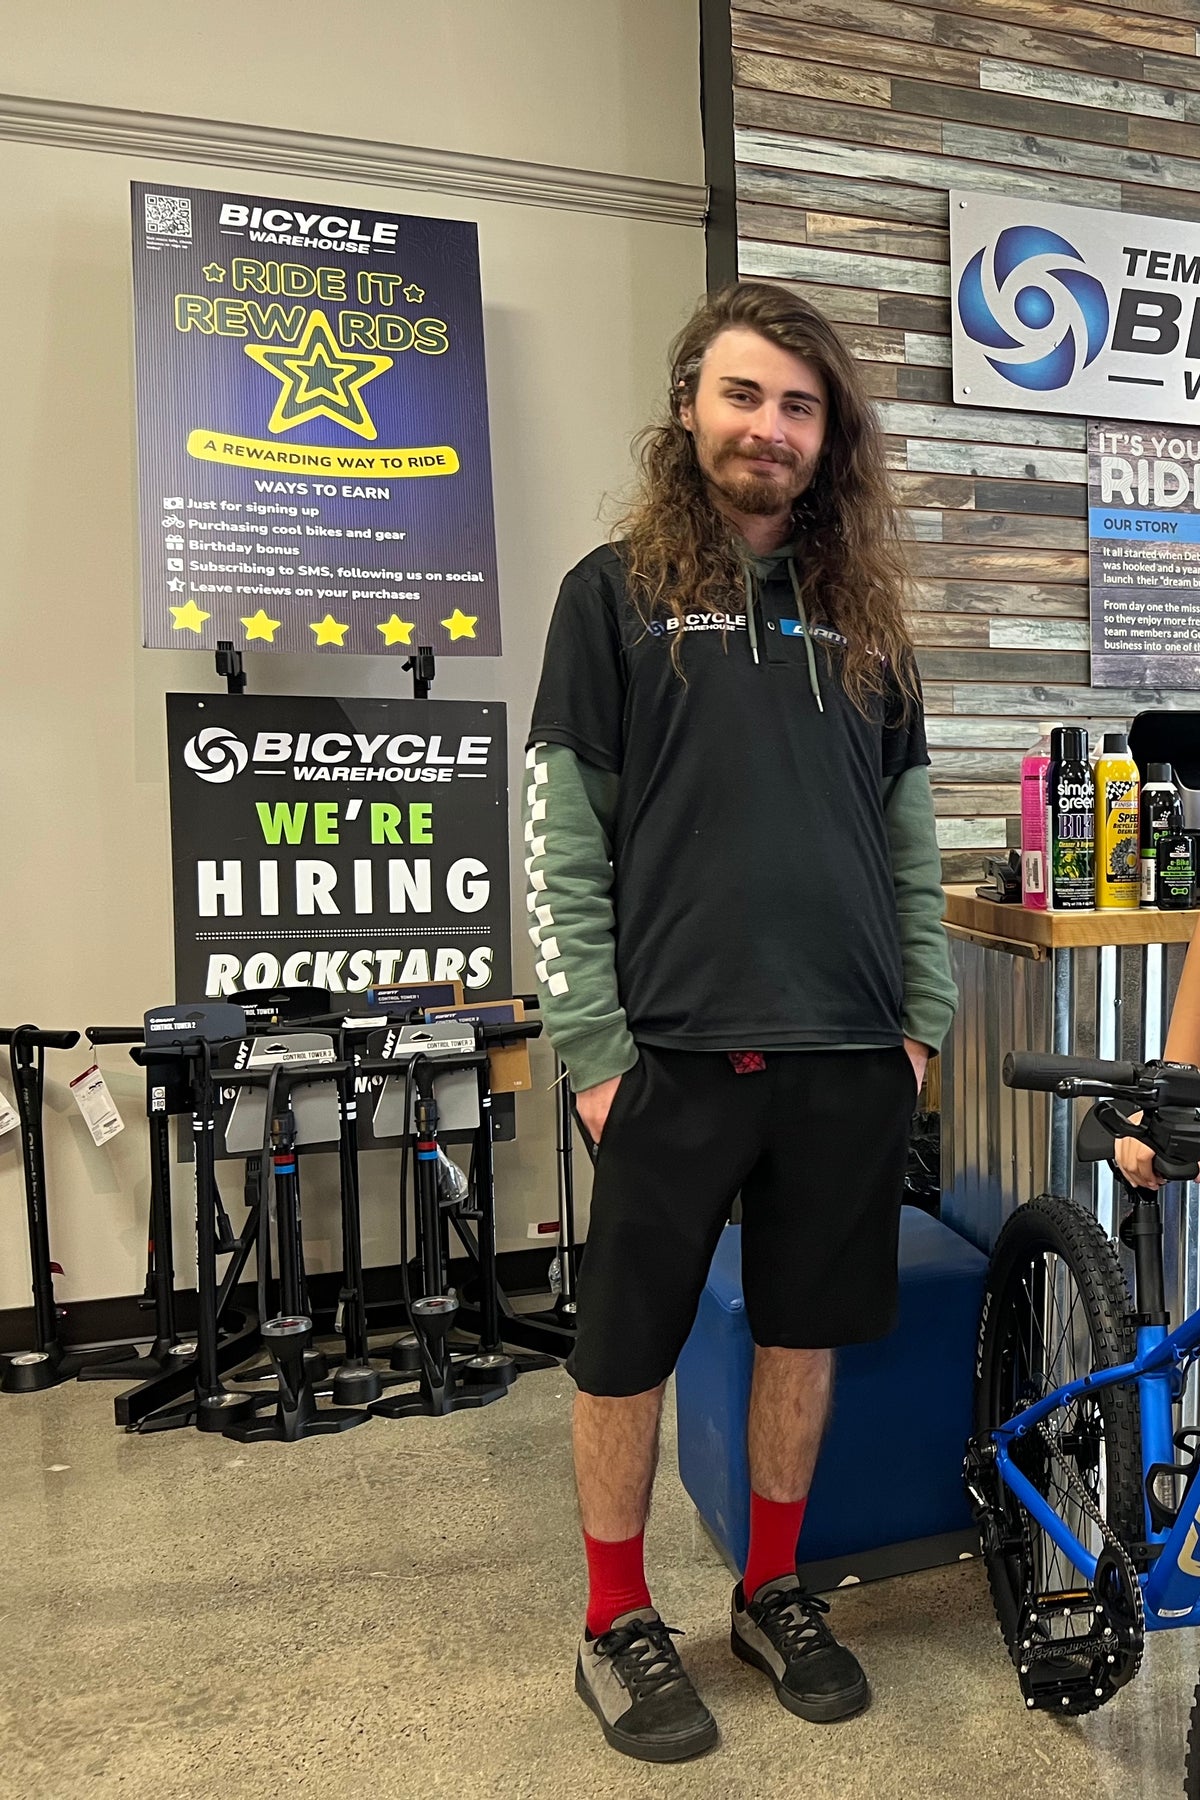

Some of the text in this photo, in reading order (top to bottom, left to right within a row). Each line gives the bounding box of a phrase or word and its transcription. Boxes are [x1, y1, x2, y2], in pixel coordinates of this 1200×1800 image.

[218, 203, 399, 245] BICYCLE
[248, 230, 370, 255] WAREHOUSE
[232, 257, 402, 307] RIDE IT
[1099, 432, 1143, 456] IT'S
[204, 440, 446, 469] A REWARDING WAY TO RIDE
[254, 480, 390, 500] WAYS TO EARN
[186, 498, 320, 518] Just for signing up
[188, 519, 406, 541] Purchasing cool bikes and gear
[1103, 518, 1178, 534] OUR STORY
[188, 540, 300, 555] Birthday bonus
[1103, 547, 1111, 556] It
[1112, 548, 1123, 557] all
[1124, 549, 1156, 559] started
[1159, 550, 1182, 560] when
[189, 560, 484, 583] Subscribing to SMS, following us on social
[1103, 562, 1121, 570] was
[1122, 561, 1156, 572] hooked
[1157, 564, 1174, 573] and
[1182, 566, 1200, 575] year
[1103, 574, 1133, 584] launch
[1137, 575, 1158, 585] their
[190, 581, 421, 601] Leave reviews on your purchases
[1103, 600, 1127, 610] From
[1129, 601, 1145, 612] day
[1147, 604, 1163, 612] one
[1165, 603, 1180, 612] the
[666, 613, 746, 632] BCYCLE
[1104, 615, 1115, 623] so
[1116, 614, 1136, 625] they
[1137, 615, 1161, 626] enjoy
[1104, 627, 1127, 637] team
[1130, 628, 1171, 638] members
[1173, 630, 1189, 639] and
[1104, 639, 1142, 650] business
[1144, 641, 1161, 651] into
[1183, 642, 1192, 651] of
[252, 732, 492, 765] BICYCLE
[293, 766, 454, 782] WAREHOUSE
[255, 799, 434, 845] WE'RE
[197, 857, 491, 916] HIRING
[205, 946, 494, 997] ROCKSTARS
[426, 1041, 450, 1049] CONTROL
[450, 1040, 468, 1048] TOWER
[282, 1053, 308, 1061] CONTROL
[976, 1291, 993, 1379] KENDA
